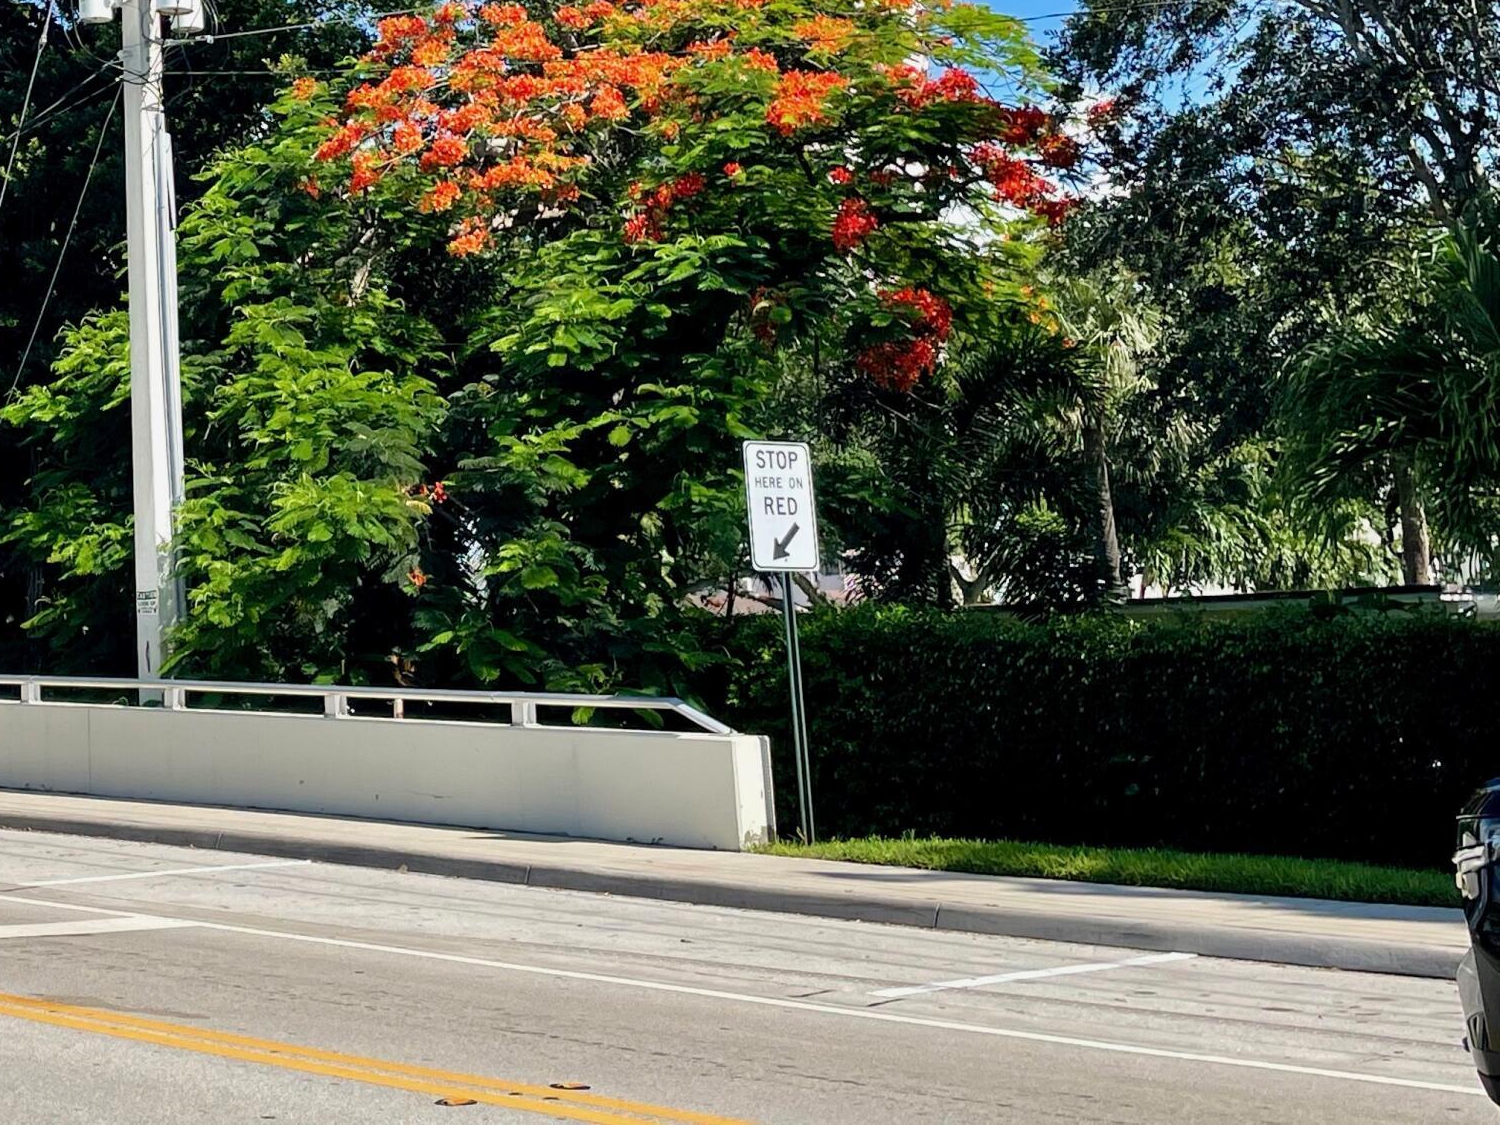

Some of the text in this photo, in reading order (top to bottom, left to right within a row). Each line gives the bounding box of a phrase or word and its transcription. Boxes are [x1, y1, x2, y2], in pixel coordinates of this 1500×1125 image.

[756, 450, 798, 470] STOP
[755, 476, 804, 490] HERE ON
[764, 496, 798, 516] RED
